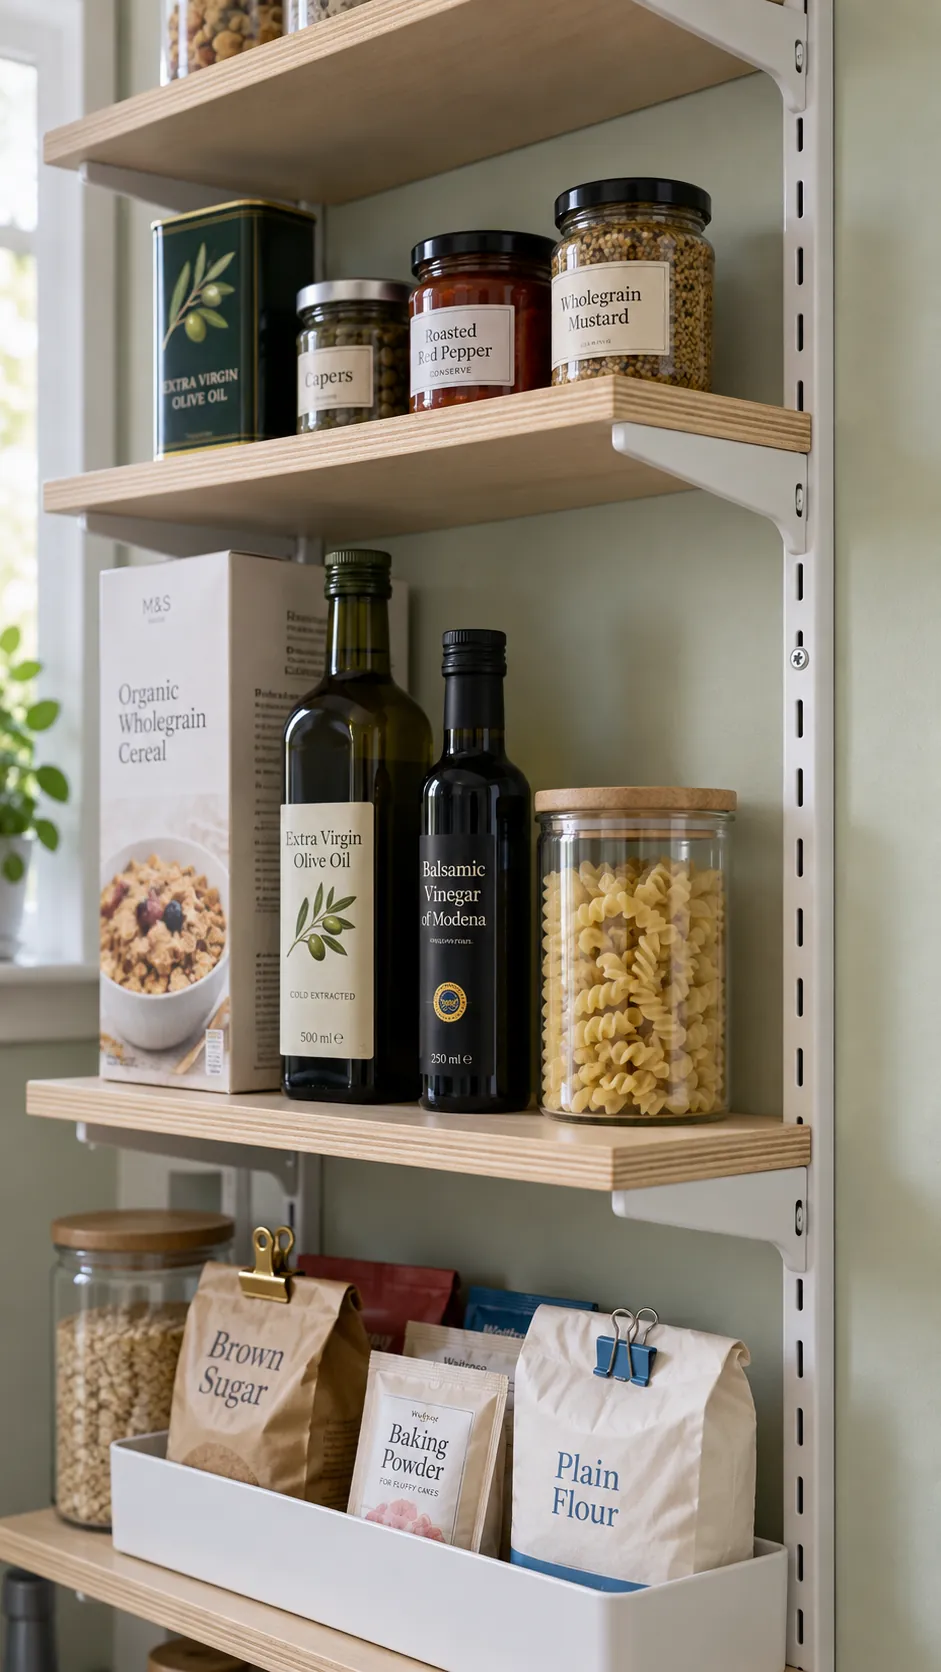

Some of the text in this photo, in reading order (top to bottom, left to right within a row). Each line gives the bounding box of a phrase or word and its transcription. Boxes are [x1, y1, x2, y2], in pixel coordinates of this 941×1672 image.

[561, 285, 642, 312] Wholegrain
[568, 307, 630, 332] Mustard
[425, 322, 477, 343] Roasted
[418, 345, 493, 366] Red Pepper
[163, 367, 239, 395] EXTRA VIRGIN
[305, 371, 354, 390] Capers
[429, 366, 472, 378] CONSERVE
[172, 387, 228, 410] OLIVE OIL
[142, 594, 172, 614] M&S
[118, 679, 179, 709] Organic
[118, 707, 207, 737] Wholegrain
[118, 739, 167, 764] Cereal
[286, 829, 363, 849] Extra Virgin
[293, 852, 351, 868] Olive Oil
[423, 860, 486, 877] Balsamic
[424, 885, 482, 907] Vinegar
[421, 910, 487, 926] of Modena
[290, 990, 356, 1001] COLD EXTRACTED
[300, 1031, 318, 1043] 500
[319, 1032, 332, 1044] ml
[430, 1053, 447, 1064] 250
[448, 1054, 460, 1064] ml
[207, 1330, 284, 1371] Brown
[198, 1365, 269, 1409] Sugar
[388, 1423, 449, 1460] Baking
[381, 1448, 444, 1480] Powder
[554, 1451, 620, 1492] Plain
[379, 1477, 392, 1487] FOR
[551, 1486, 620, 1528] Flour
